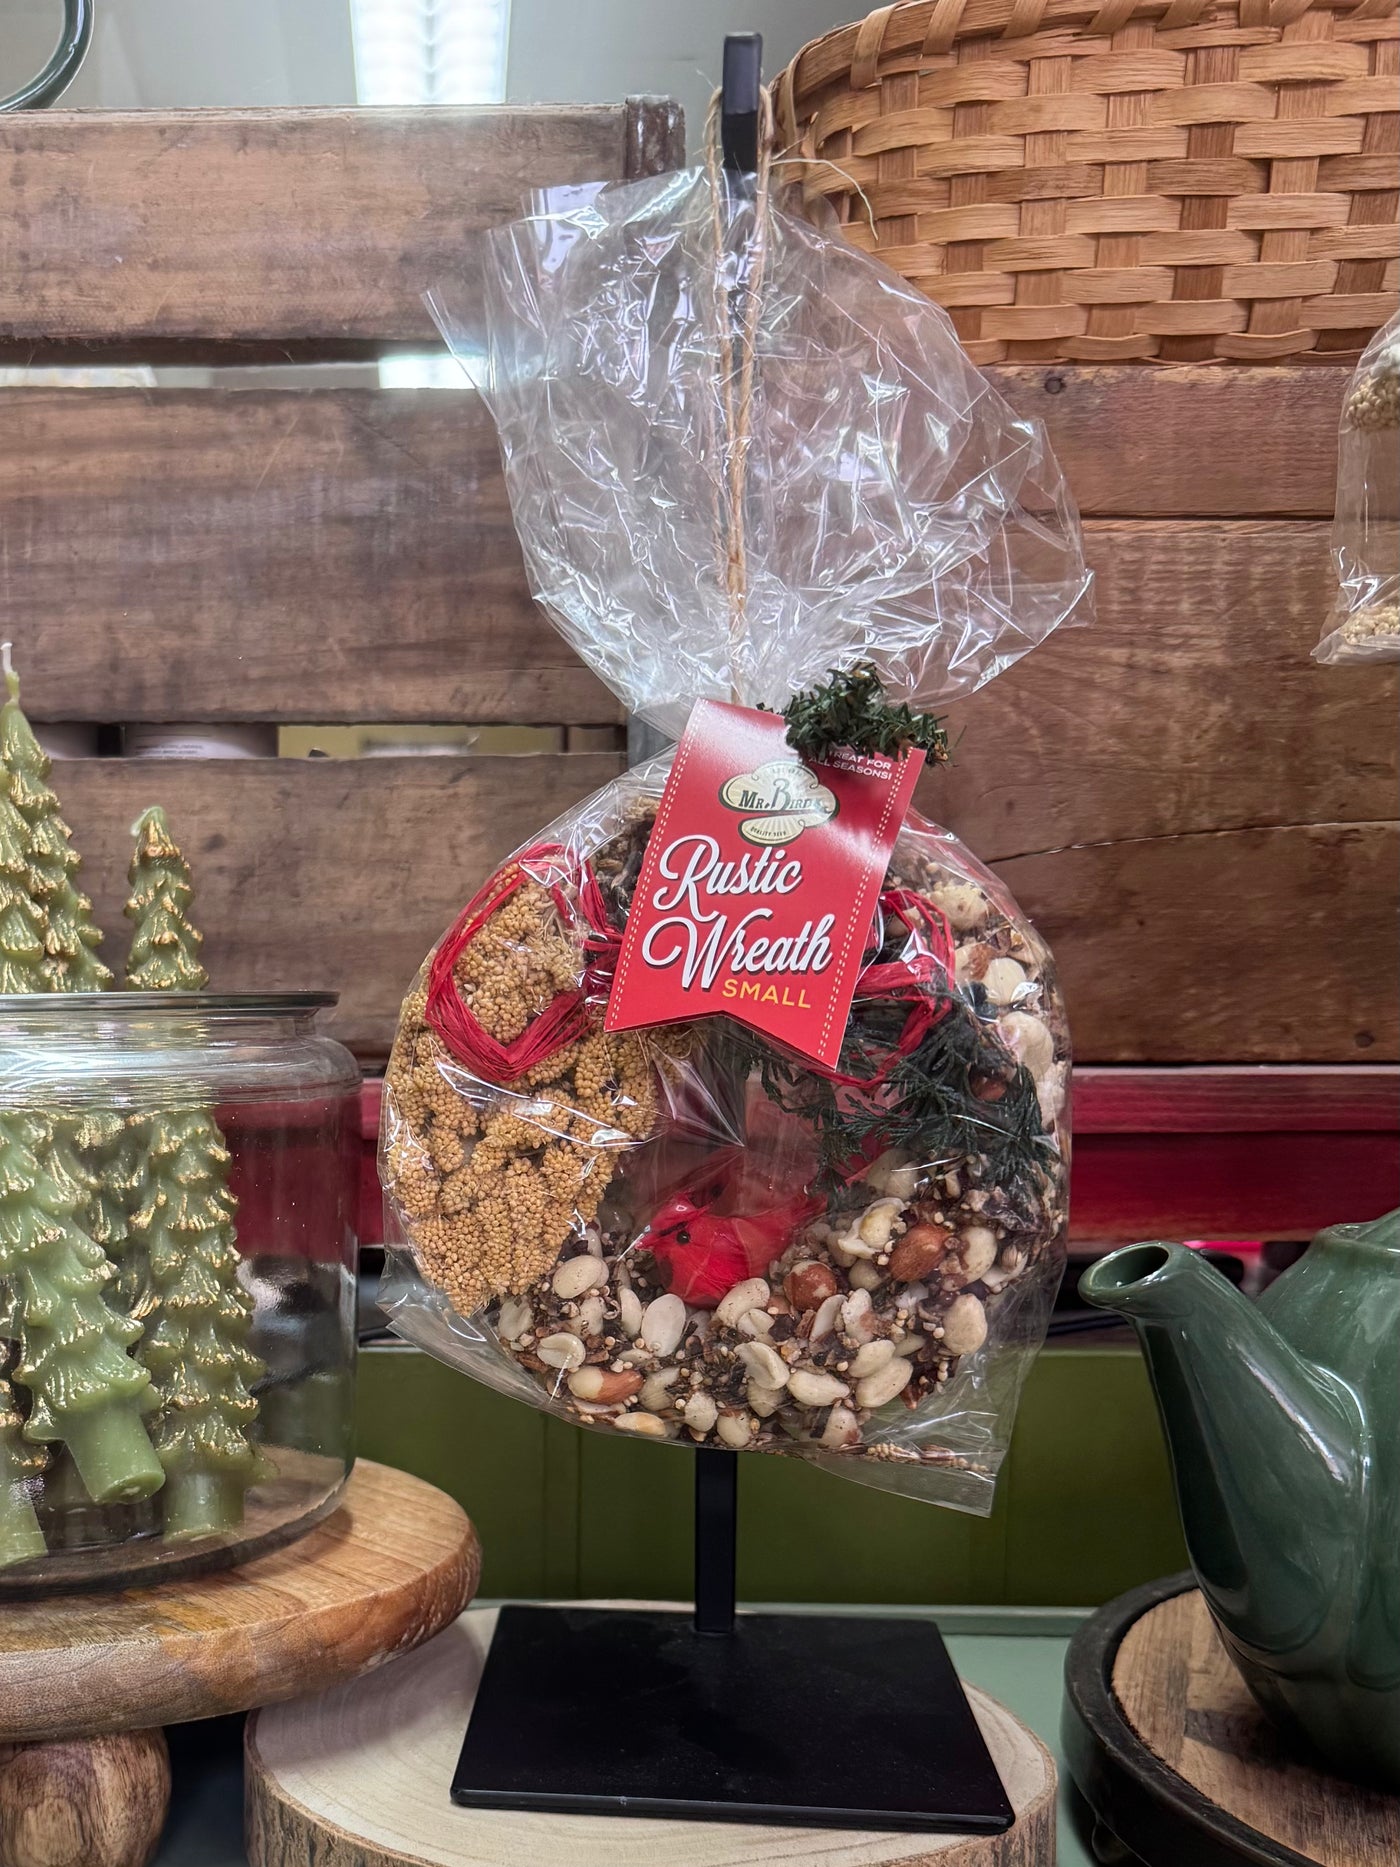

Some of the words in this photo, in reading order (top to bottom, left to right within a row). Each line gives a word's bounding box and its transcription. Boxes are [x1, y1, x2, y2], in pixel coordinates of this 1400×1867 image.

[832, 760, 893, 780] SEASONS!
[867, 758, 892, 770] FOR
[653, 834, 803, 922] Rustic
[642, 908, 832, 990] Wreath
[721, 978, 812, 1008] SMALL
